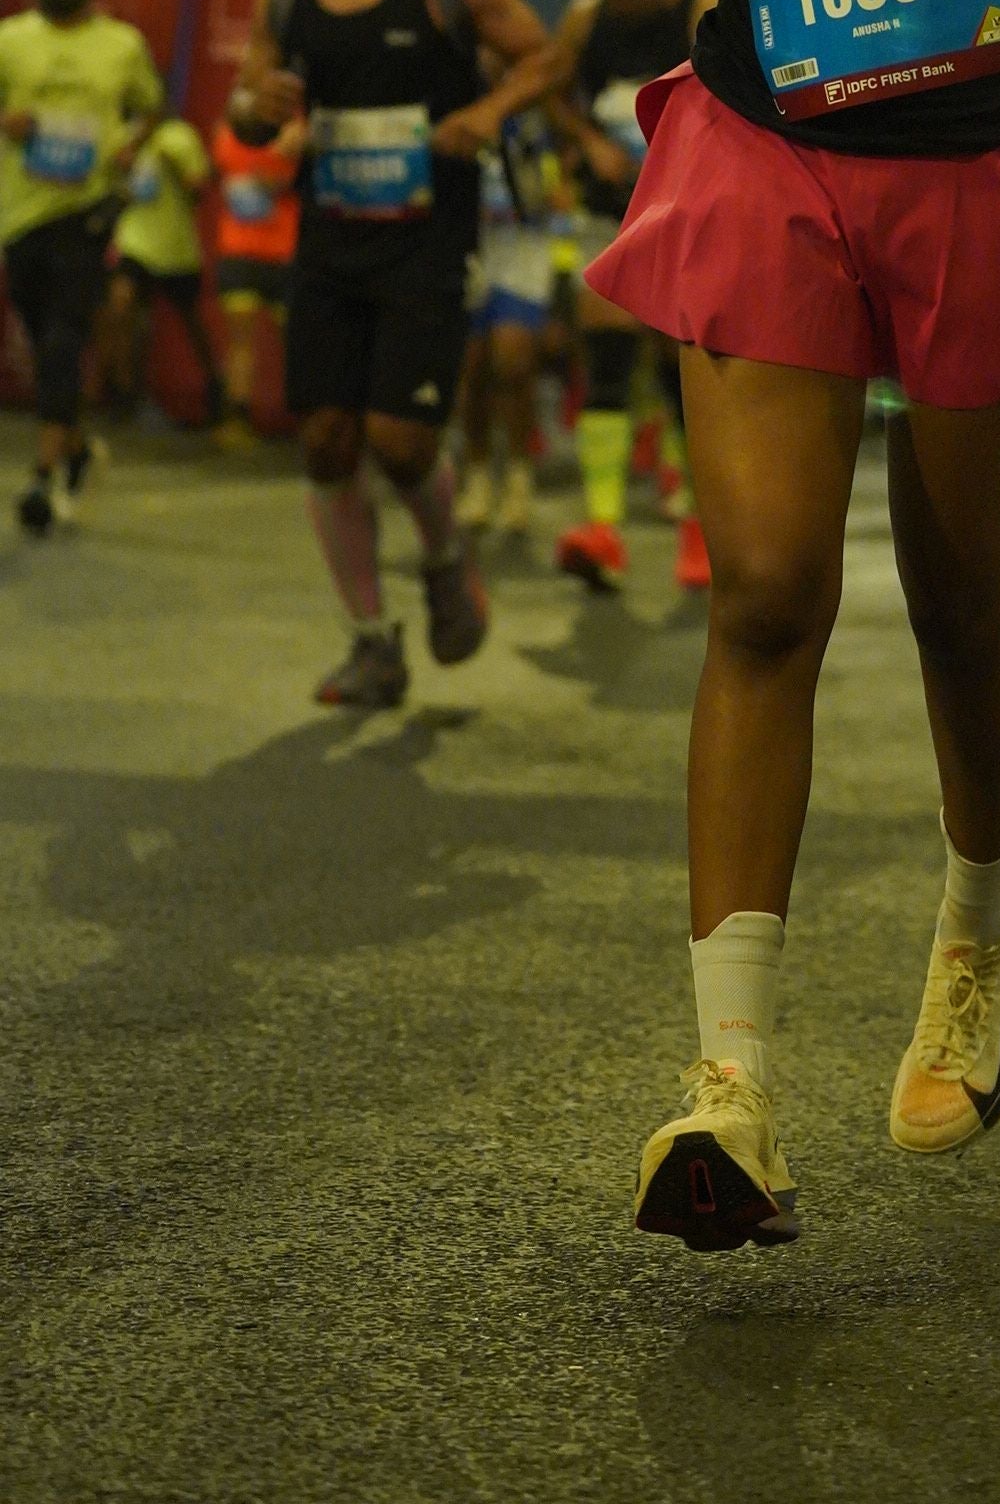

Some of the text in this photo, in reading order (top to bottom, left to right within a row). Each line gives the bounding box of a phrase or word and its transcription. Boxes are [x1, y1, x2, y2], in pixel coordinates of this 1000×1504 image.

[853, 20, 892, 38] ANUSHA
[846, 61, 956, 94] IDFC FIRST Bank
